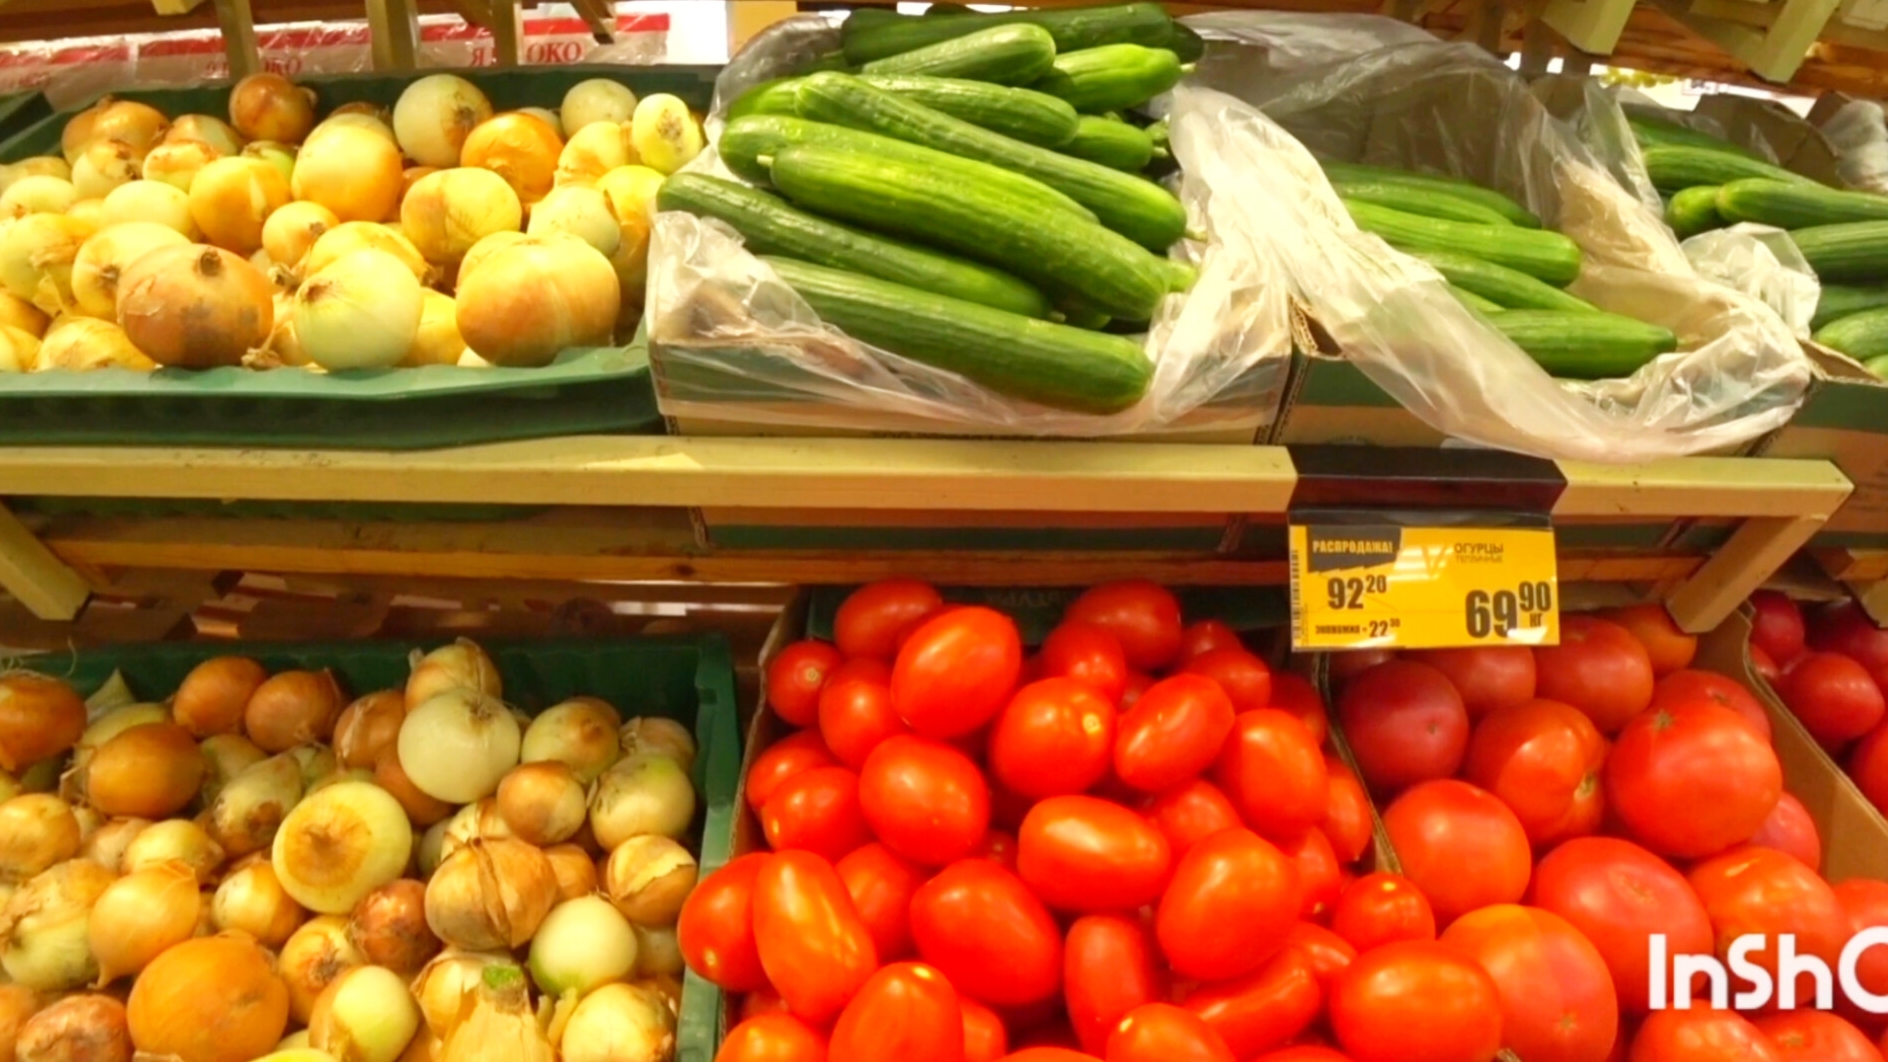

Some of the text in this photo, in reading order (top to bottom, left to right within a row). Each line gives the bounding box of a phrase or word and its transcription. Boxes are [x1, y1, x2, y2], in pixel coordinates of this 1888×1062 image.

[1312, 540, 1393, 554] РАСПРОДАЖА!
[1453, 542, 1504, 555] ОГУРЦЫ
[1327, 575, 1387, 610] 92 20
[1465, 581, 1552, 639] 69 90
[1369, 620, 1389, 638] 22
